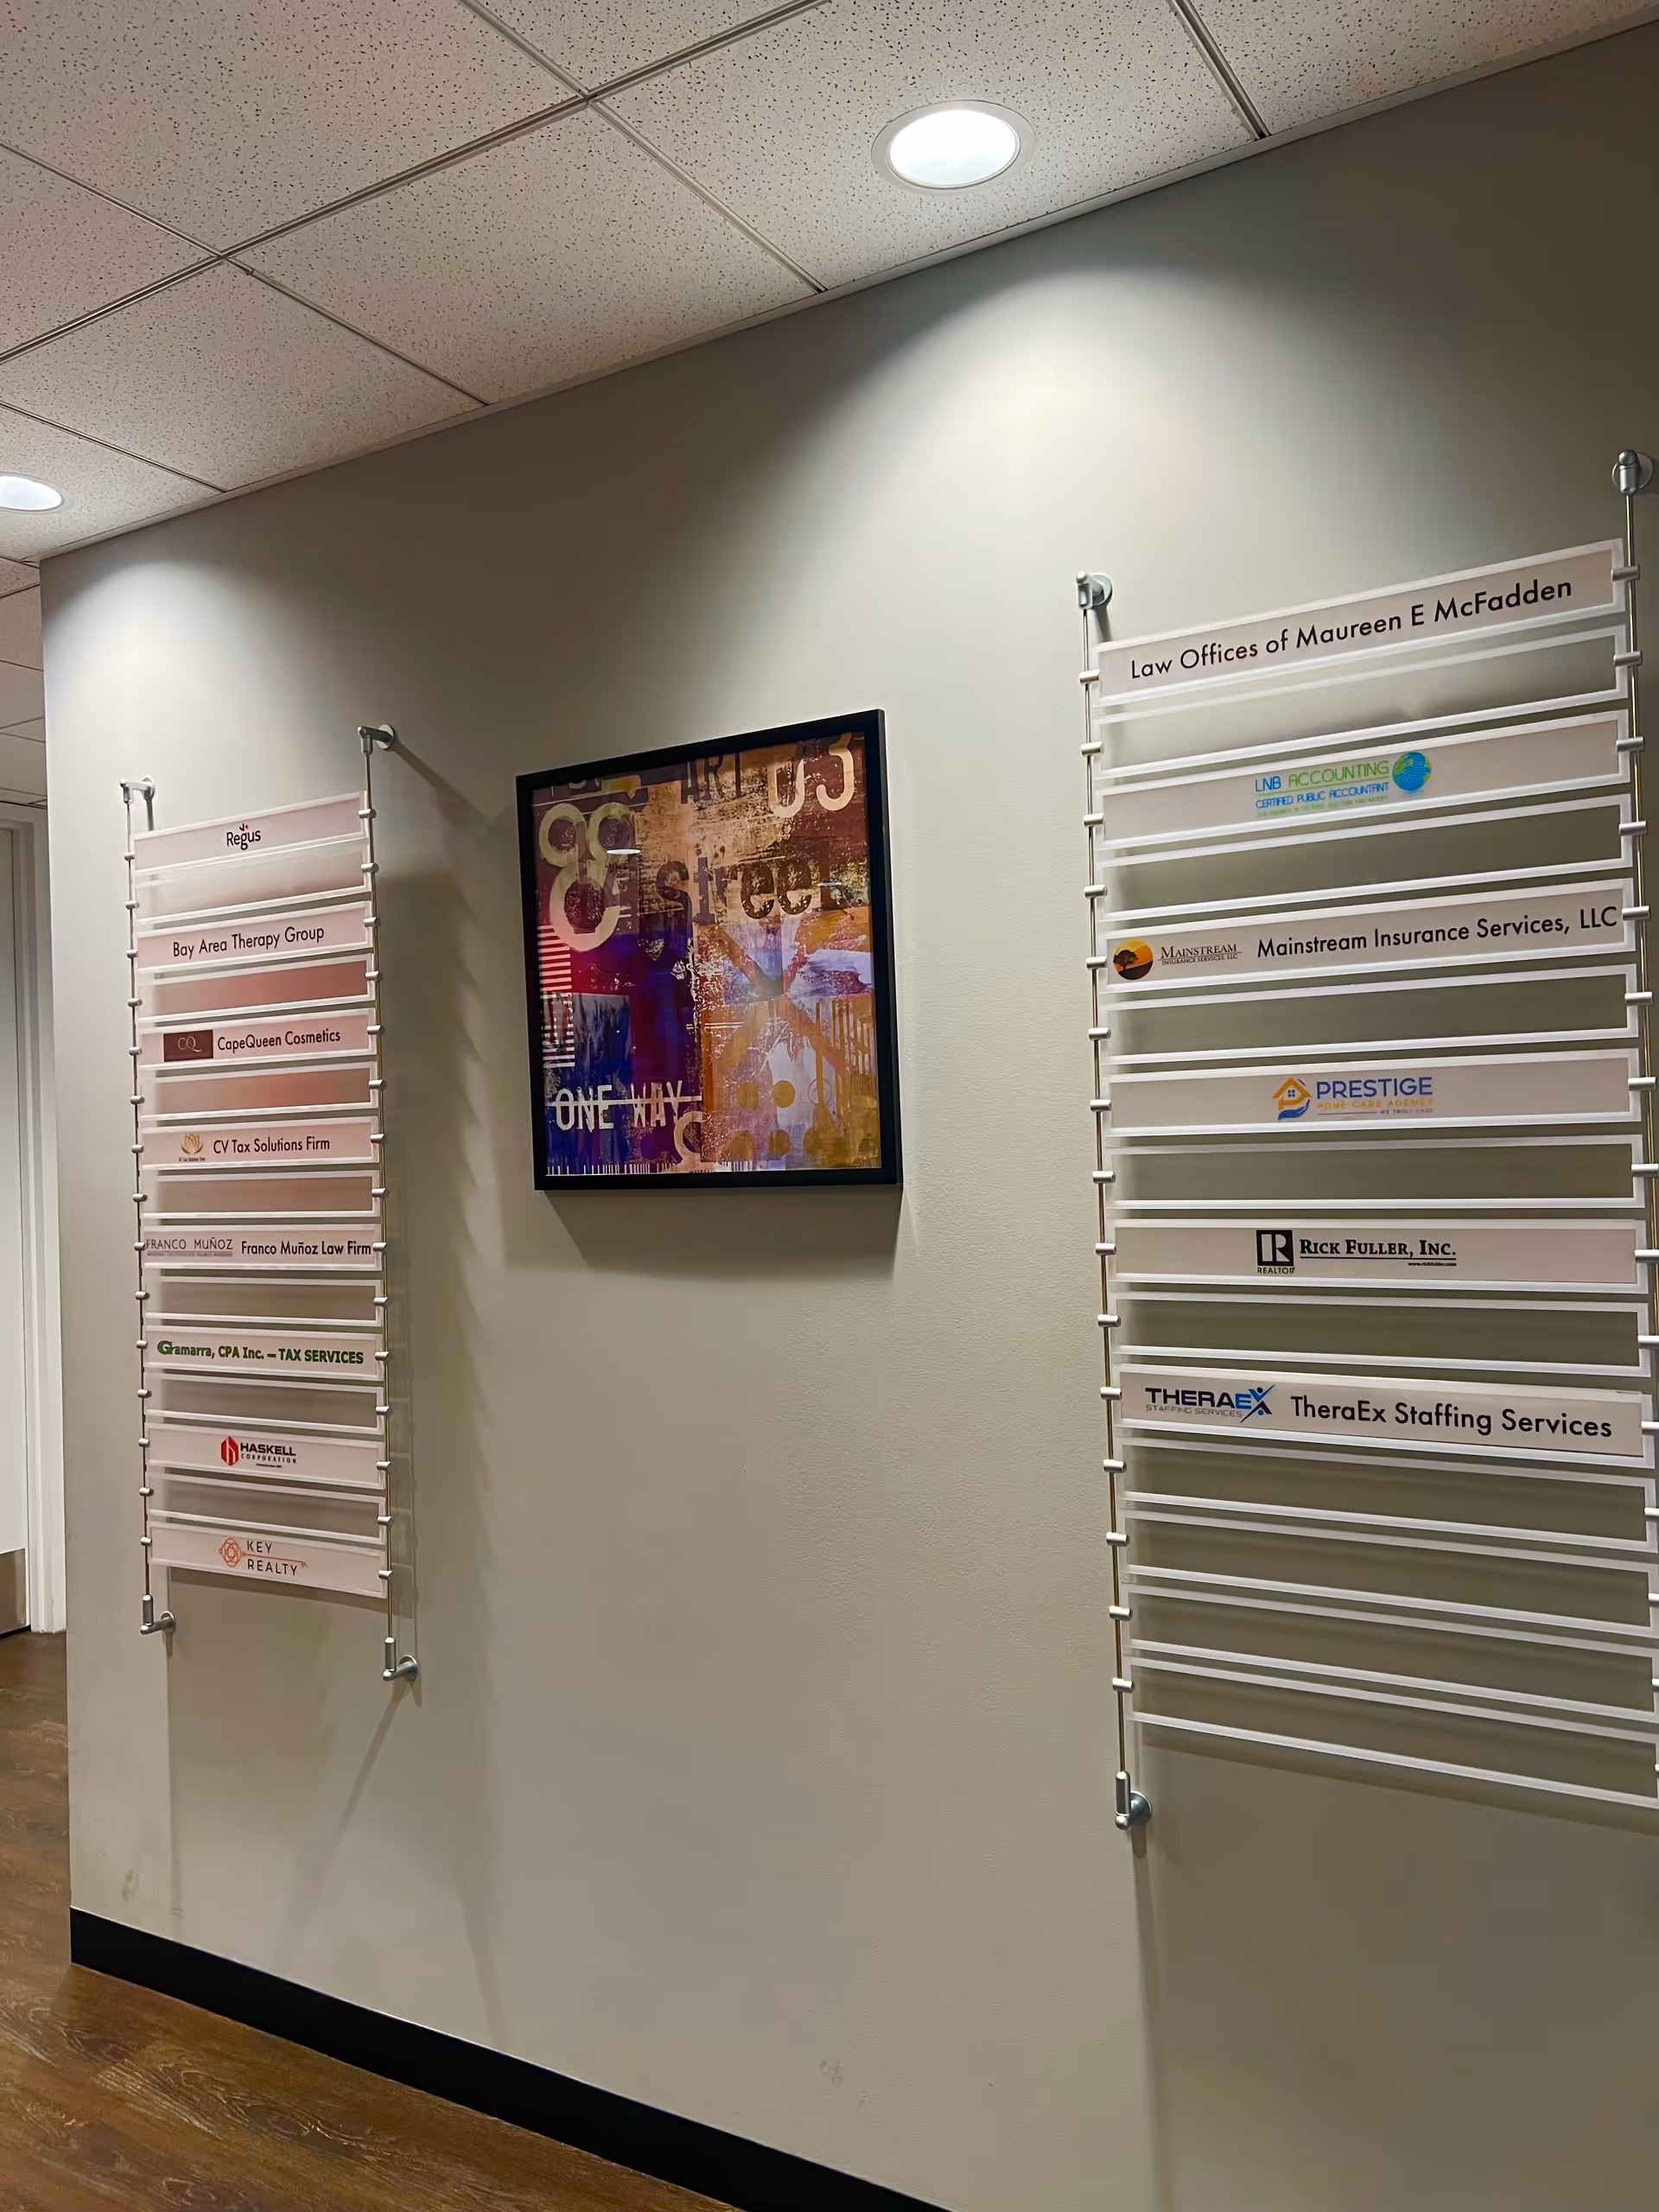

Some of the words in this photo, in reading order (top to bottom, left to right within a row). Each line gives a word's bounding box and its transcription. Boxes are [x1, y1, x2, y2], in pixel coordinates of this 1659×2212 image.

[1130, 656, 1173, 679] Law
[1180, 641, 1258, 670] Offices
[1265, 629, 1288, 654] of
[1296, 613, 1402, 650] Maureen
[1411, 604, 1425, 626] E
[1434, 578, 1573, 621] McFadden
[1255, 776, 1281, 792] LNB
[1288, 760, 1389, 788] ACCOUNTING
[1255, 795, 1294, 809] CERTIFIED
[1297, 791, 1325, 803] PUBLIC
[1329, 782, 1389, 798] ACCOUNTANT
[226, 830, 262, 850] Regus
[1257, 935, 1367, 957] Mainstream
[1374, 925, 1470, 947] Insurance
[1477, 913, 1570, 939] Services,
[1580, 906, 1618, 929] LLC
[173, 942, 195, 959] Bay
[199, 938, 227, 954] Area
[232, 932, 280, 950] Therapy
[285, 926, 325, 944] Group
[1160, 944, 1237, 958] MAINSTREAM
[177, 1037, 202, 1052] CQ
[218, 1034, 282, 1053] CapeQueen
[285, 1028, 340, 1046] Cosmetics
[1316, 1077, 1433, 1099] PRESTIGE
[556, 1085, 613, 1132] ONE
[631, 1080, 683, 1128] WAY
[213, 1140, 229, 1154] CV
[232, 1139, 251, 1153] Tax
[253, 1136, 302, 1153] Solutions
[306, 1136, 330, 1151] Firm
[146, 1238, 187, 1250] FRANCO
[194, 1236, 233, 1250] MUÑOZ
[241, 1241, 276, 1255] Franco
[281, 1241, 319, 1255] Muñoz
[321, 1241, 343, 1255] Law
[347, 1241, 372, 1255] Firm
[1300, 1239, 1340, 1254] RICK
[1345, 1239, 1414, 1258] FULLER,
[1420, 1239, 1456, 1255] INC.
[218, 1346, 239, 1357] CPA
[243, 1347, 264, 1359] Inc.
[279, 1348, 301, 1361] TAX
[304, 1349, 364, 1363] SERVICES
[1146, 1404, 1192, 1414] STAFFING
[1291, 1395, 1387, 1423] TheraEx
[1395, 1402, 1491, 1436] Staffing
[1502, 1408, 1611, 1438] Services
[239, 1442, 296, 1457] HASKELL
[247, 1540, 273, 1554] KEY
[247, 1559, 298, 1576] REALTY
